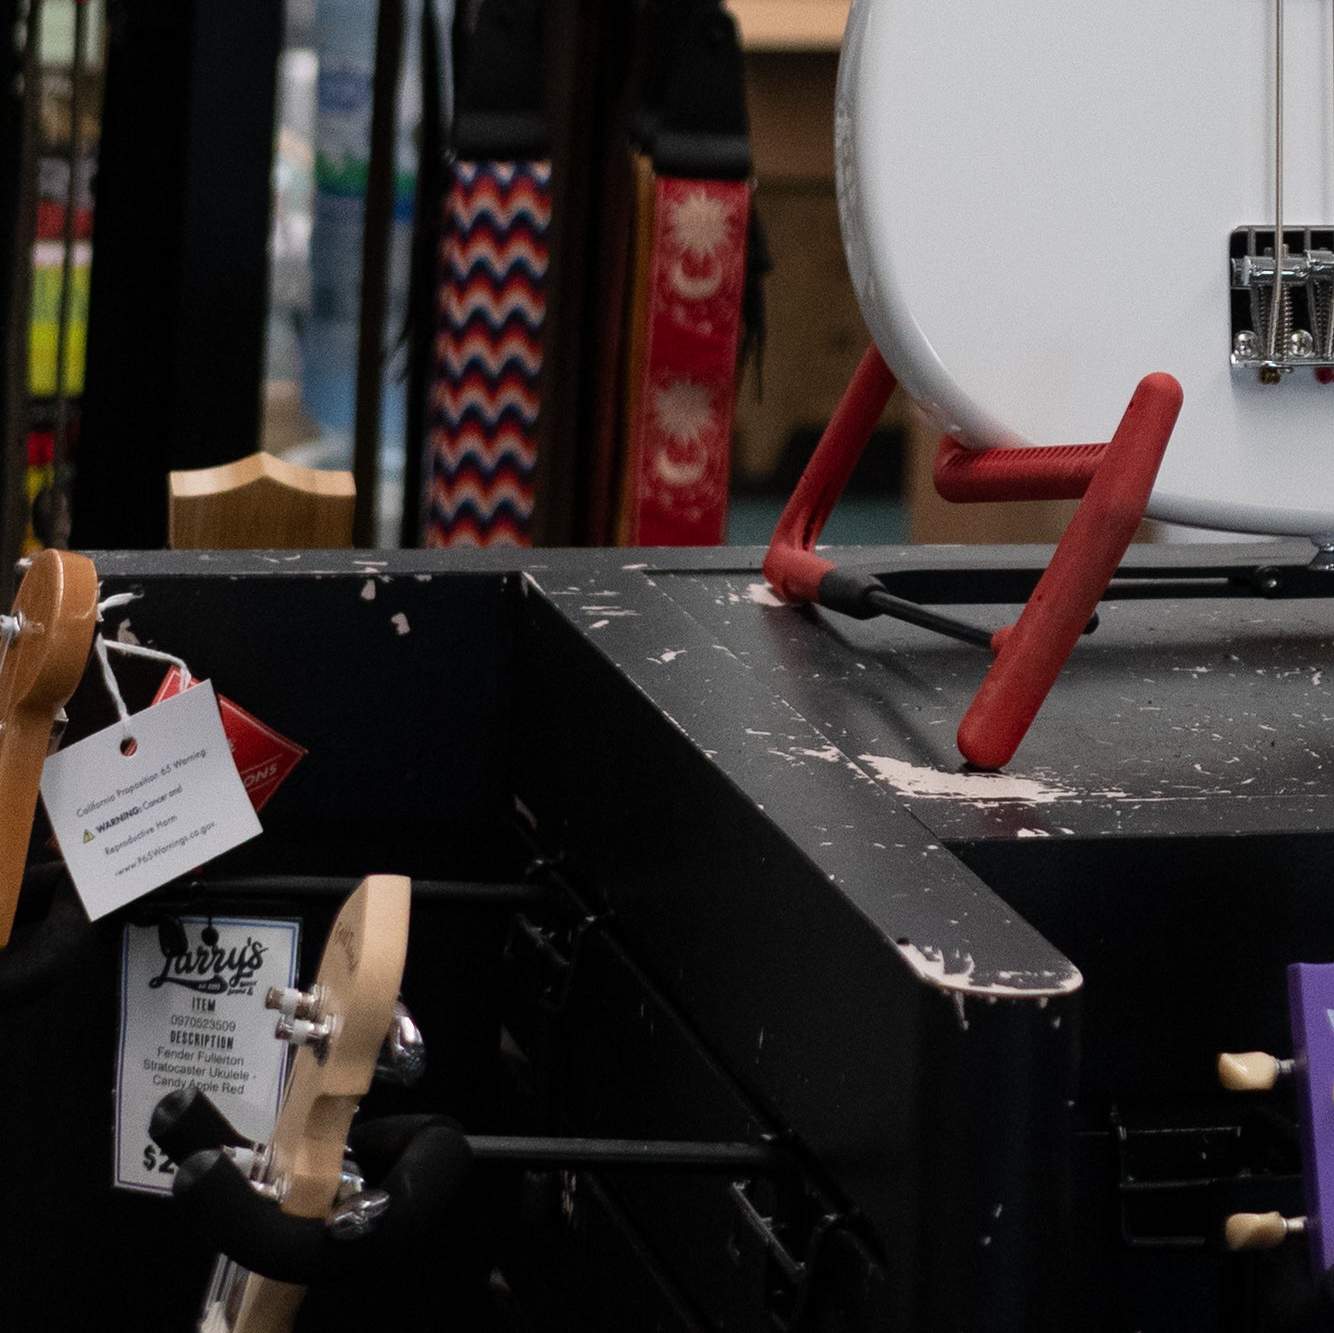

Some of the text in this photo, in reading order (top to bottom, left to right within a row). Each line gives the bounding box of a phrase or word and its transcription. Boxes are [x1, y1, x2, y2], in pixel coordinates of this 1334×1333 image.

[76, 748, 206, 818] California Proposition 65 Warning
[96, 784, 183, 835] WARNING: Cancer and
[104, 814, 178, 856] Reproductive Harm
[192, 996, 216, 1012] ITEM
[169, 1029, 234, 1050] DESCRIPTION
[157, 1046, 244, 1066] Fender Fullerton
[143, 1059, 207, 1077] Stratocaster
[209, 1065, 249, 1081] Ukulele
[152, 1074, 245, 1095] Candy Apple Red
